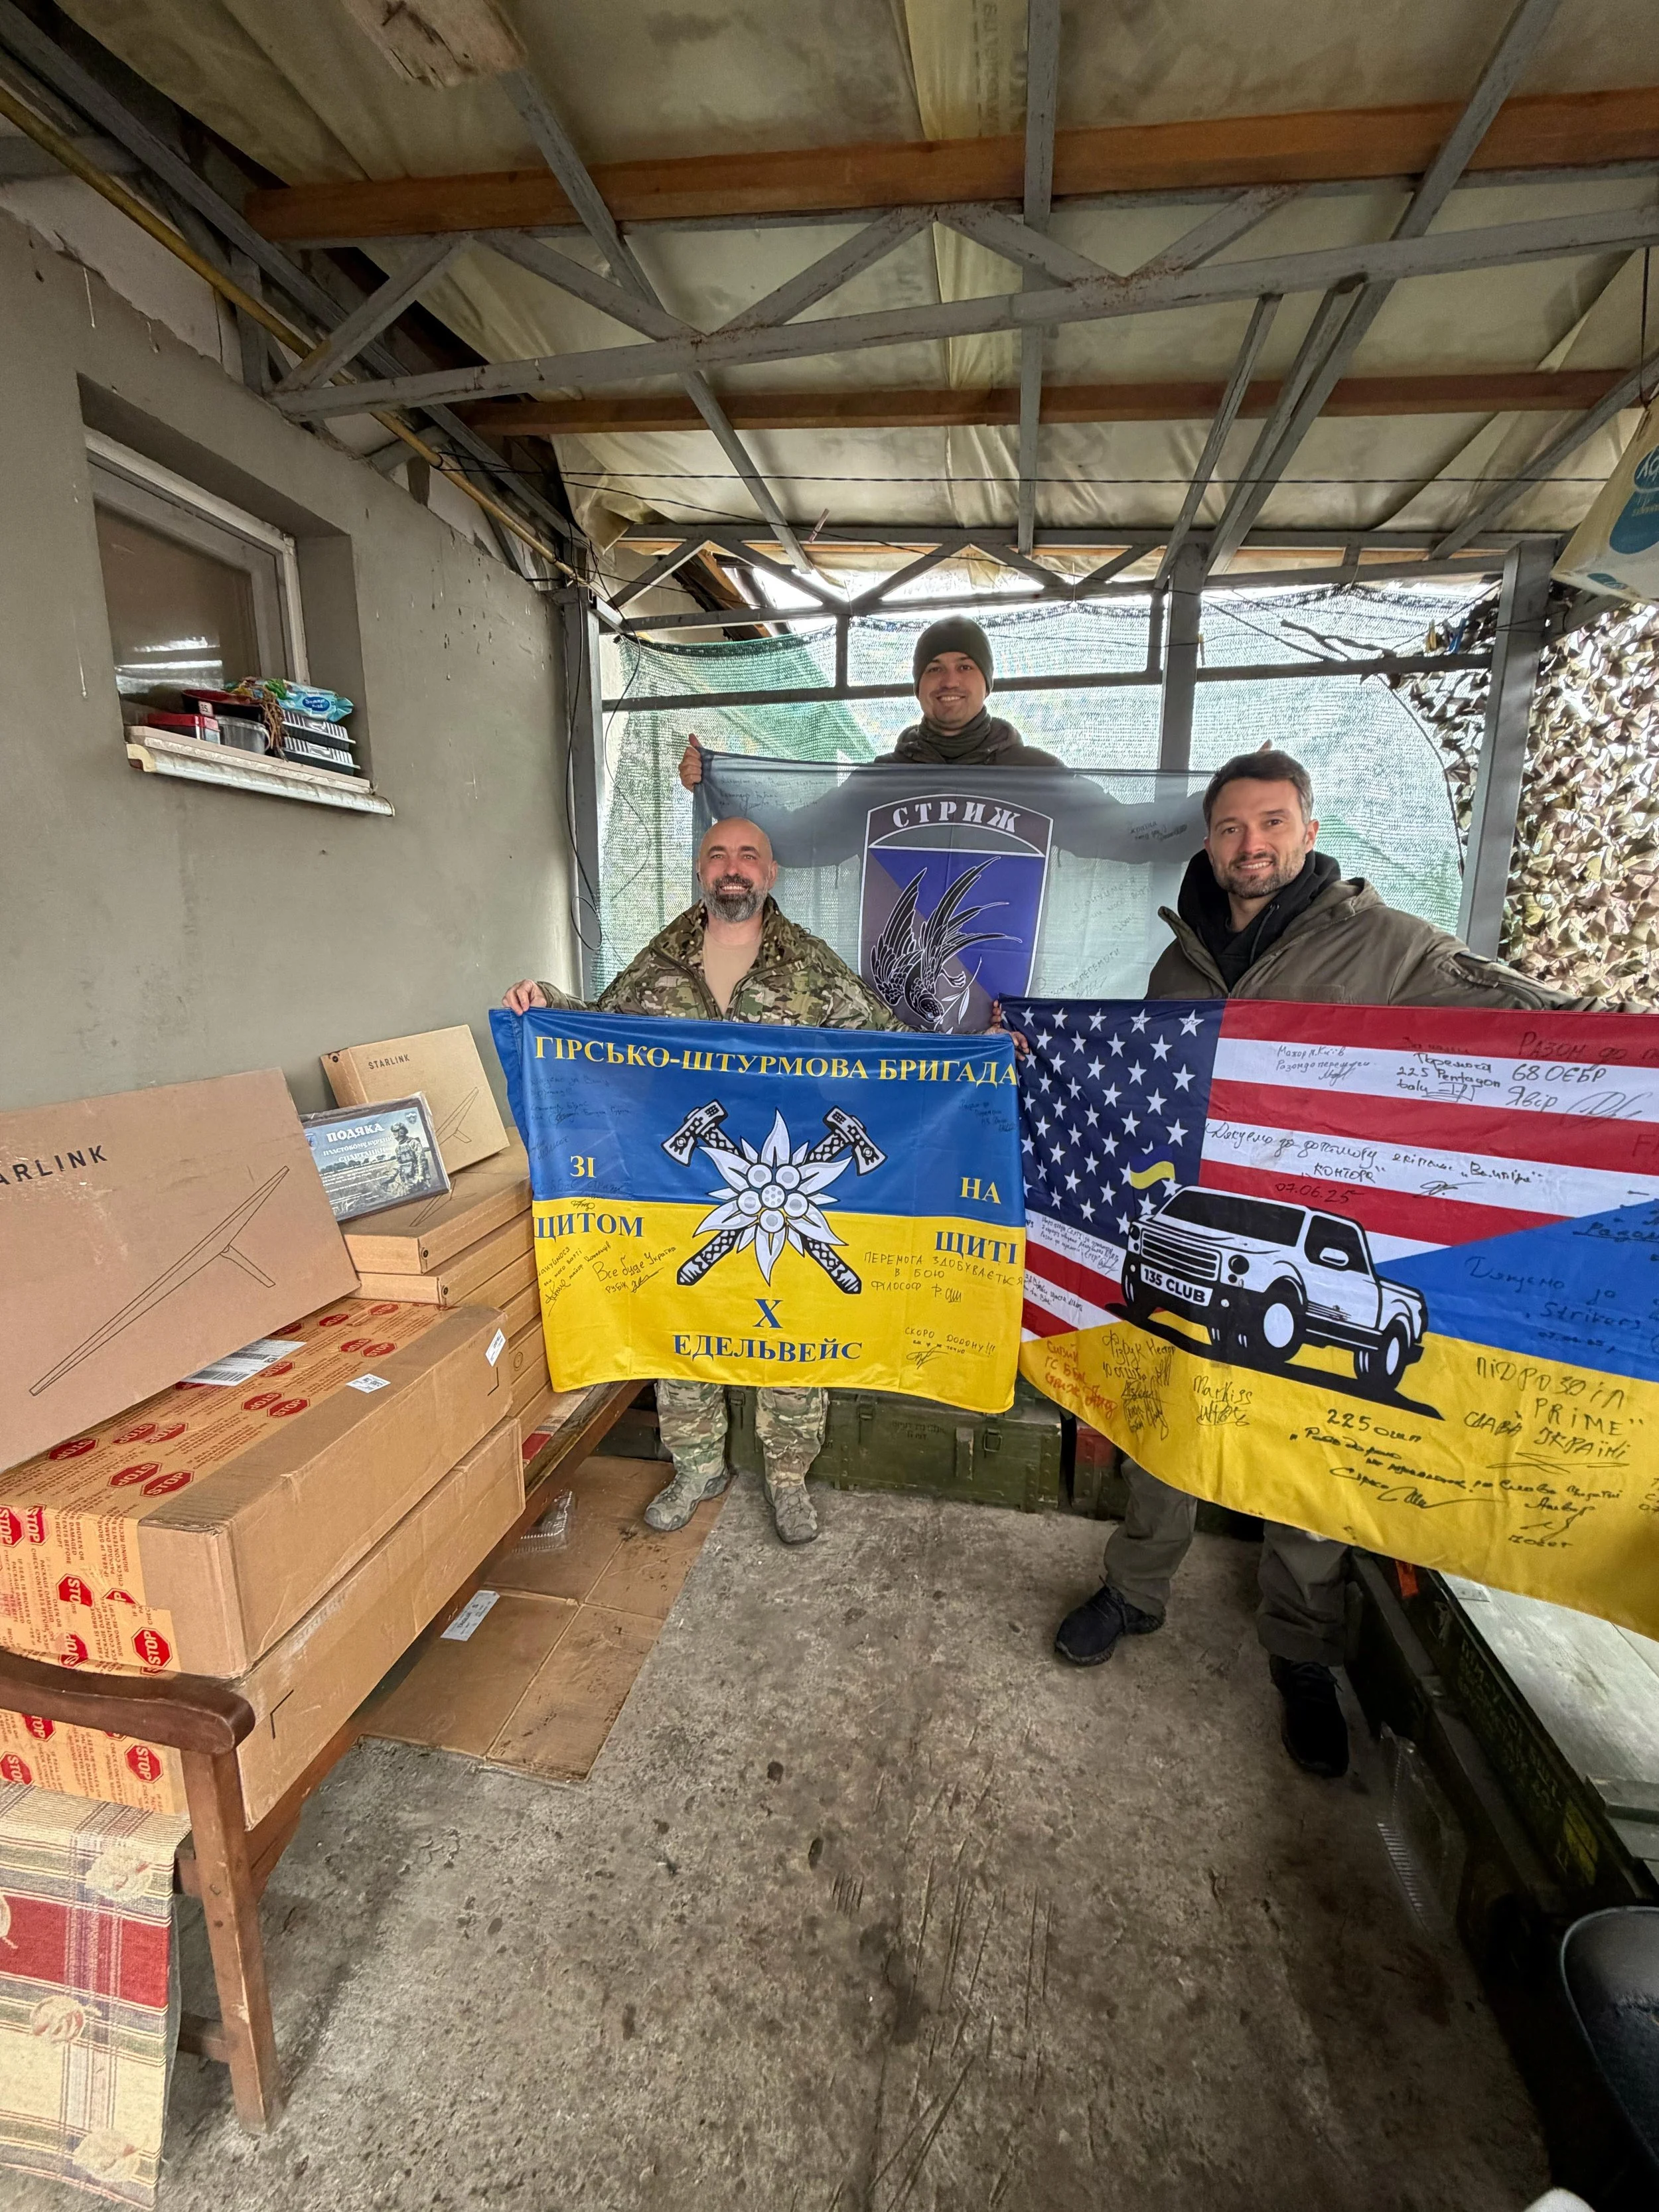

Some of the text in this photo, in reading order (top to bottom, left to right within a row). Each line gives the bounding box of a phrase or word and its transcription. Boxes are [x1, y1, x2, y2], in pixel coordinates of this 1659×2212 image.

[893, 801, 1021, 832] СТРИЖ
[368, 1054, 410, 1070] STARLINK
[535, 1036, 1018, 1088] ГІРСЬКО-ШТУРМОВА БРИГАДА
[1512, 1064, 1541, 1082] 68
[1396, 1067, 1501, 1088] 225 Pentagon
[325, 1122, 386, 1143] ПОДЯКА
[569, 1155, 597, 1179] ЗІ
[960, 1176, 1002, 1205] НА
[864, 1252, 924, 1265] ПЕРЕМОГА
[934, 1231, 1019, 1265] ЩИТІ
[592, 1260, 618, 1282] Все
[1144, 1268, 1206, 1303] 135 CLUB
[904, 1327, 935, 1339] СКОРО
[366, 1343, 391, 1357] STOP
[672, 1335, 863, 1363] ЕДЕЛЬВЕЙС
[250, 1393, 279, 1410] STOP
[272, 1398, 302, 1417] STOP
[120, 1423, 153, 1443] STOP
[56, 1439, 94, 1460] STOP
[117, 1462, 157, 1487] STOP
[147, 1471, 185, 1496] STOP
[27, 1507, 40, 1543] STOP
[67, 1578, 81, 1604] STO
[143, 1631, 161, 1667] STOP
[31, 1715, 46, 1738] TOP
[136, 1746, 151, 1780] STOP
